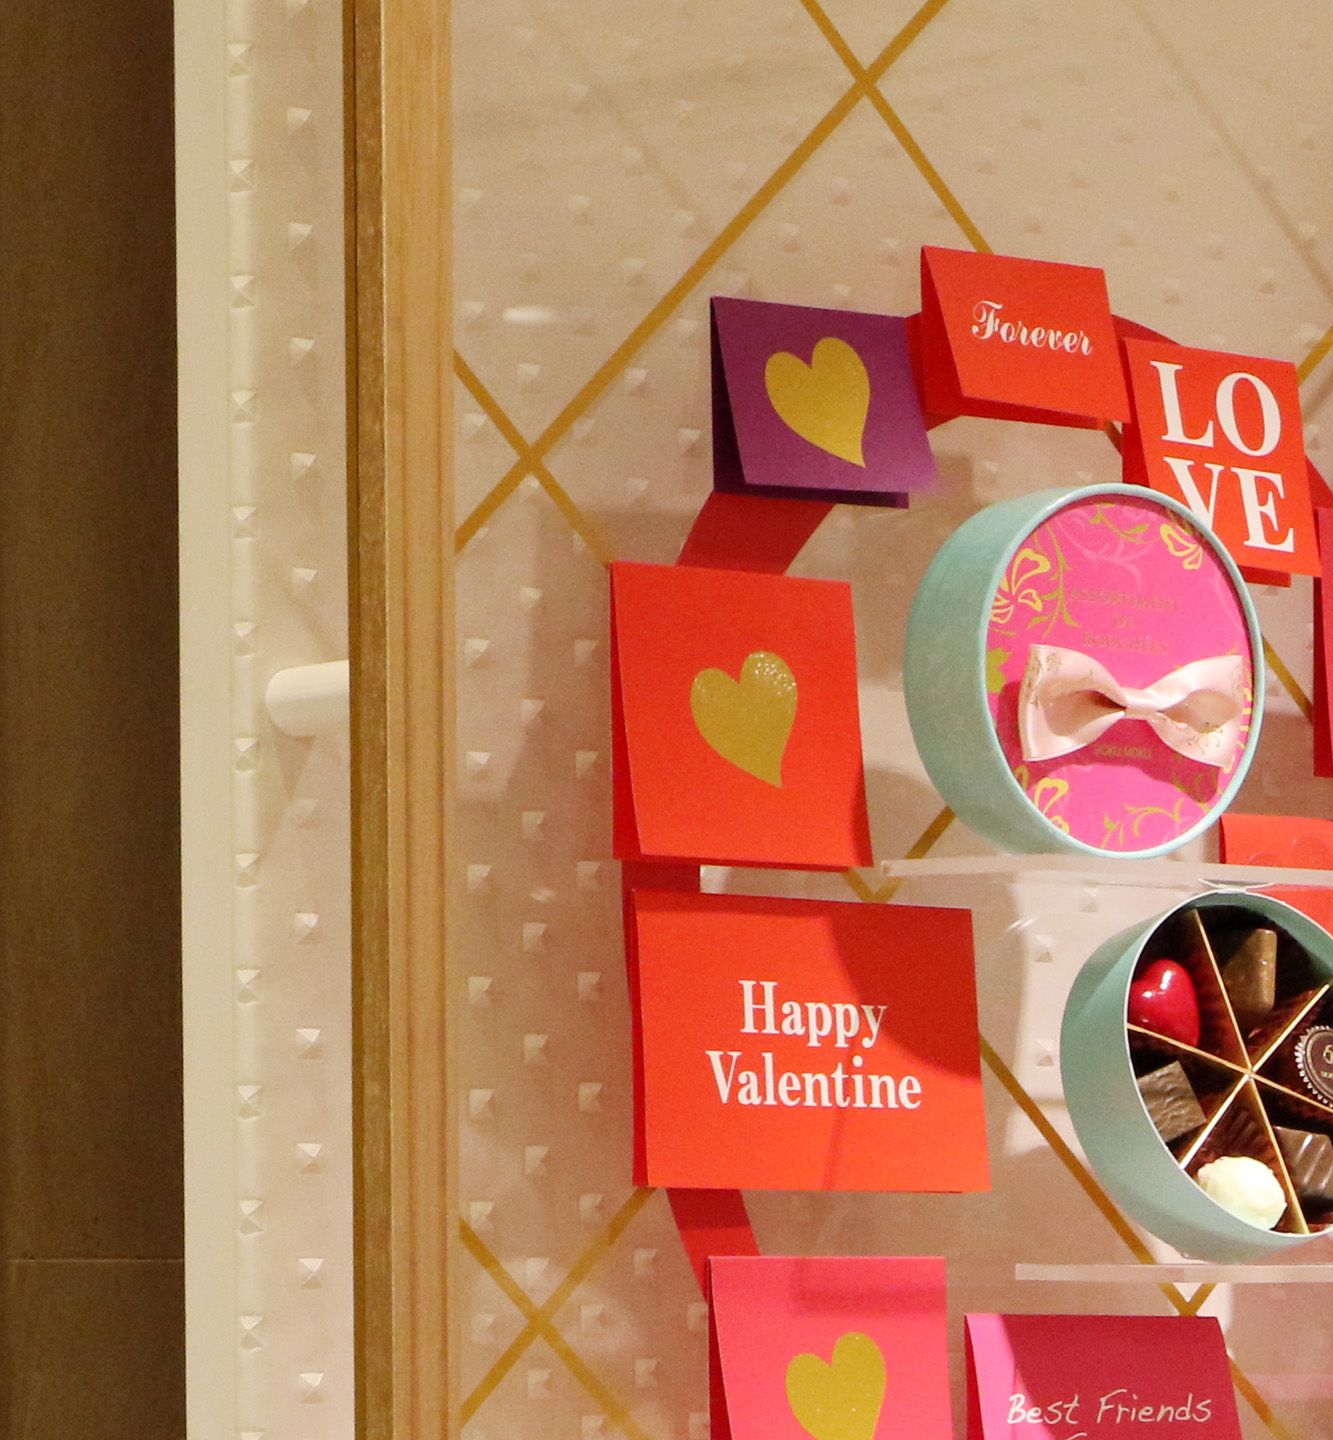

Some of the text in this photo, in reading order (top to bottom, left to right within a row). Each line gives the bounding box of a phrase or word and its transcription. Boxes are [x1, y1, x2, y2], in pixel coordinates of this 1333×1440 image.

[970, 299, 1093, 357] Forever
[738, 979, 888, 1049] Happy
[704, 1049, 922, 1110] Valentine
[1006, 1388, 1213, 1425] Best Friends
